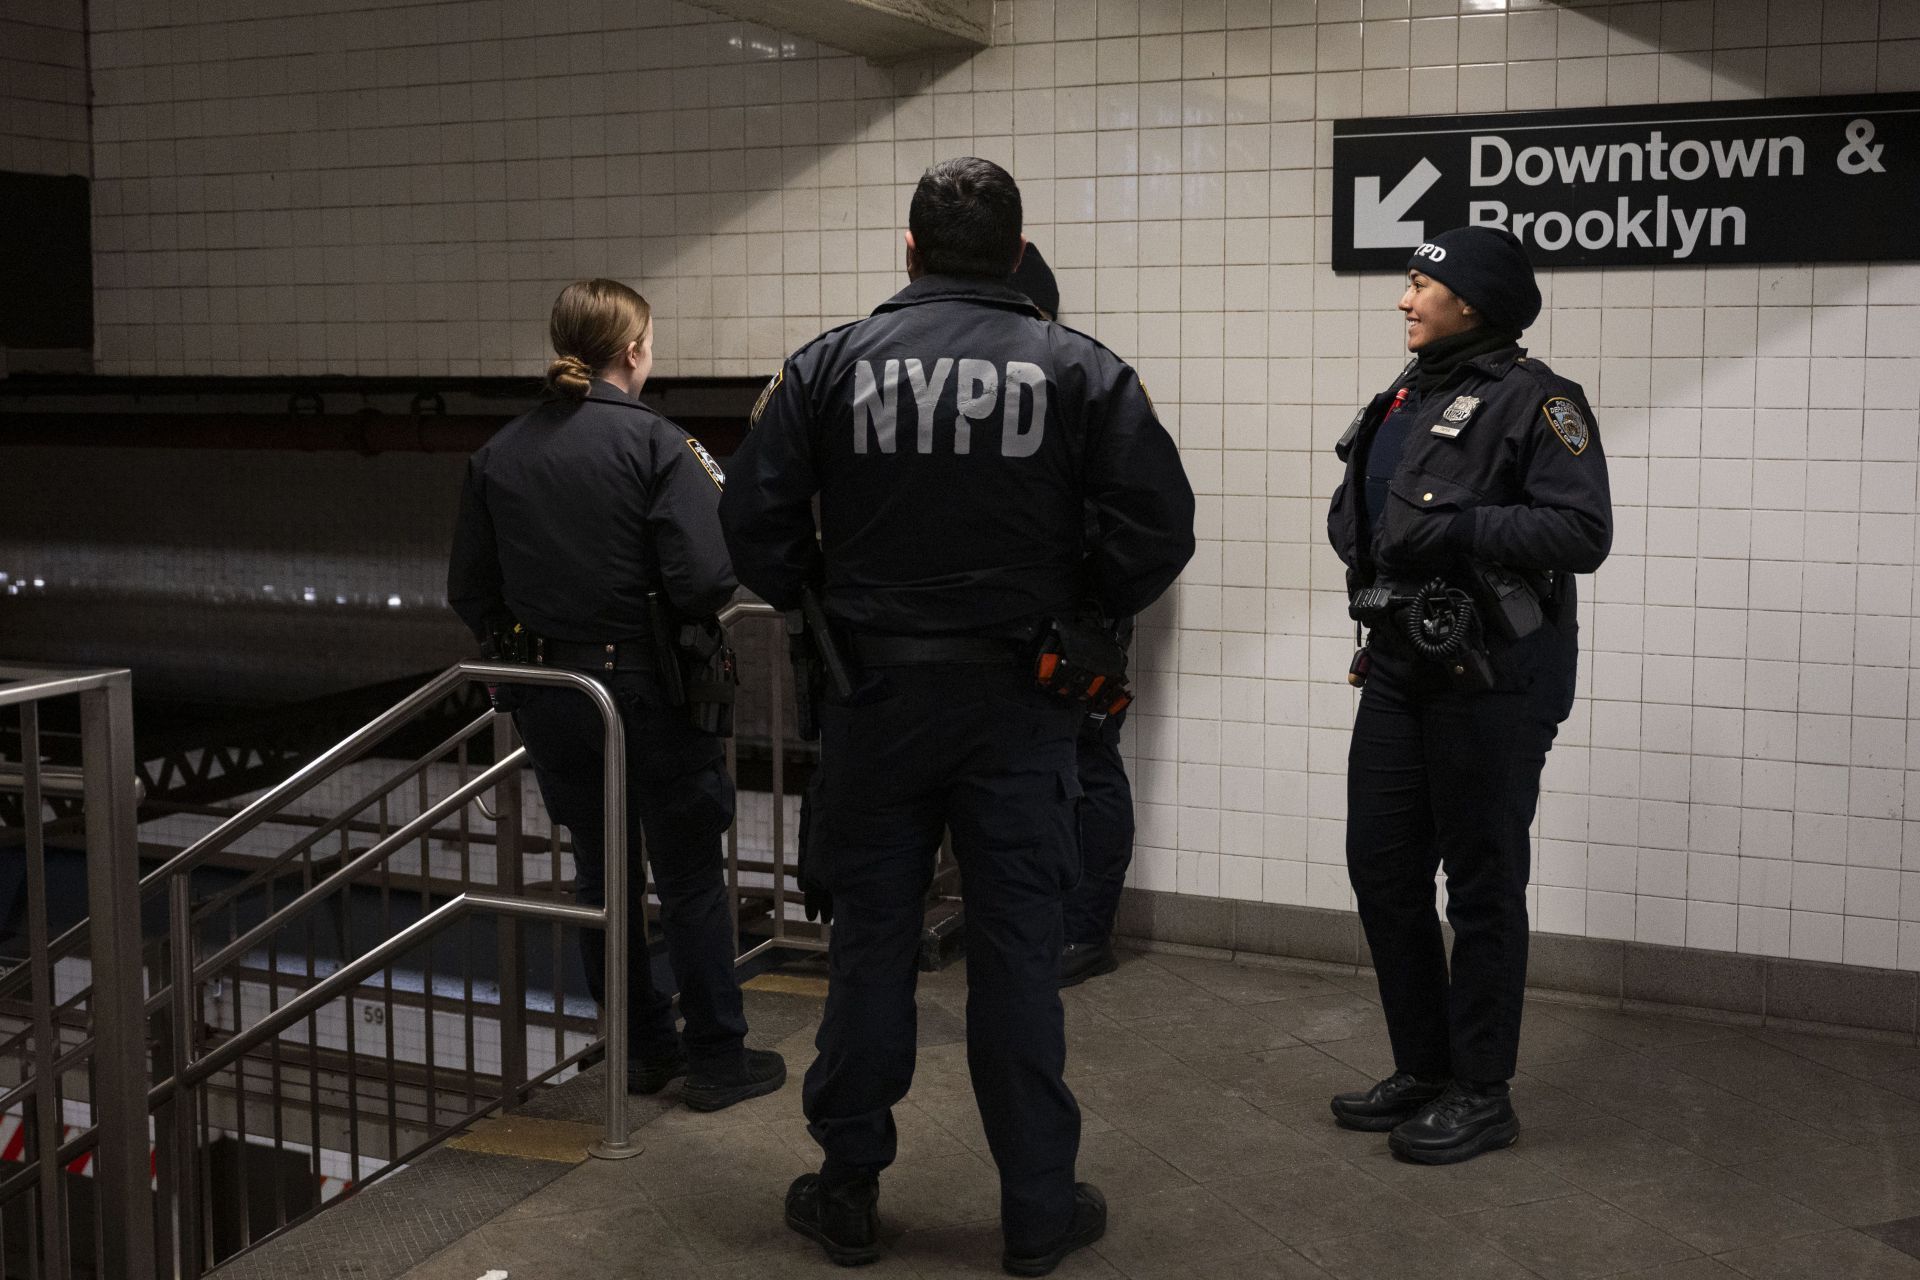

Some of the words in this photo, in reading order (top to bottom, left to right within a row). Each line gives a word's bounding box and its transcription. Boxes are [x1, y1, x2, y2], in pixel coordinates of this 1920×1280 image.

[1469, 131, 1805, 187] Downtown
[1836, 119, 1887, 175] &
[1469, 195, 1747, 258] Brooklyn
[853, 358, 1047, 457] NYPD
[364, 1005, 384, 1025] 59
